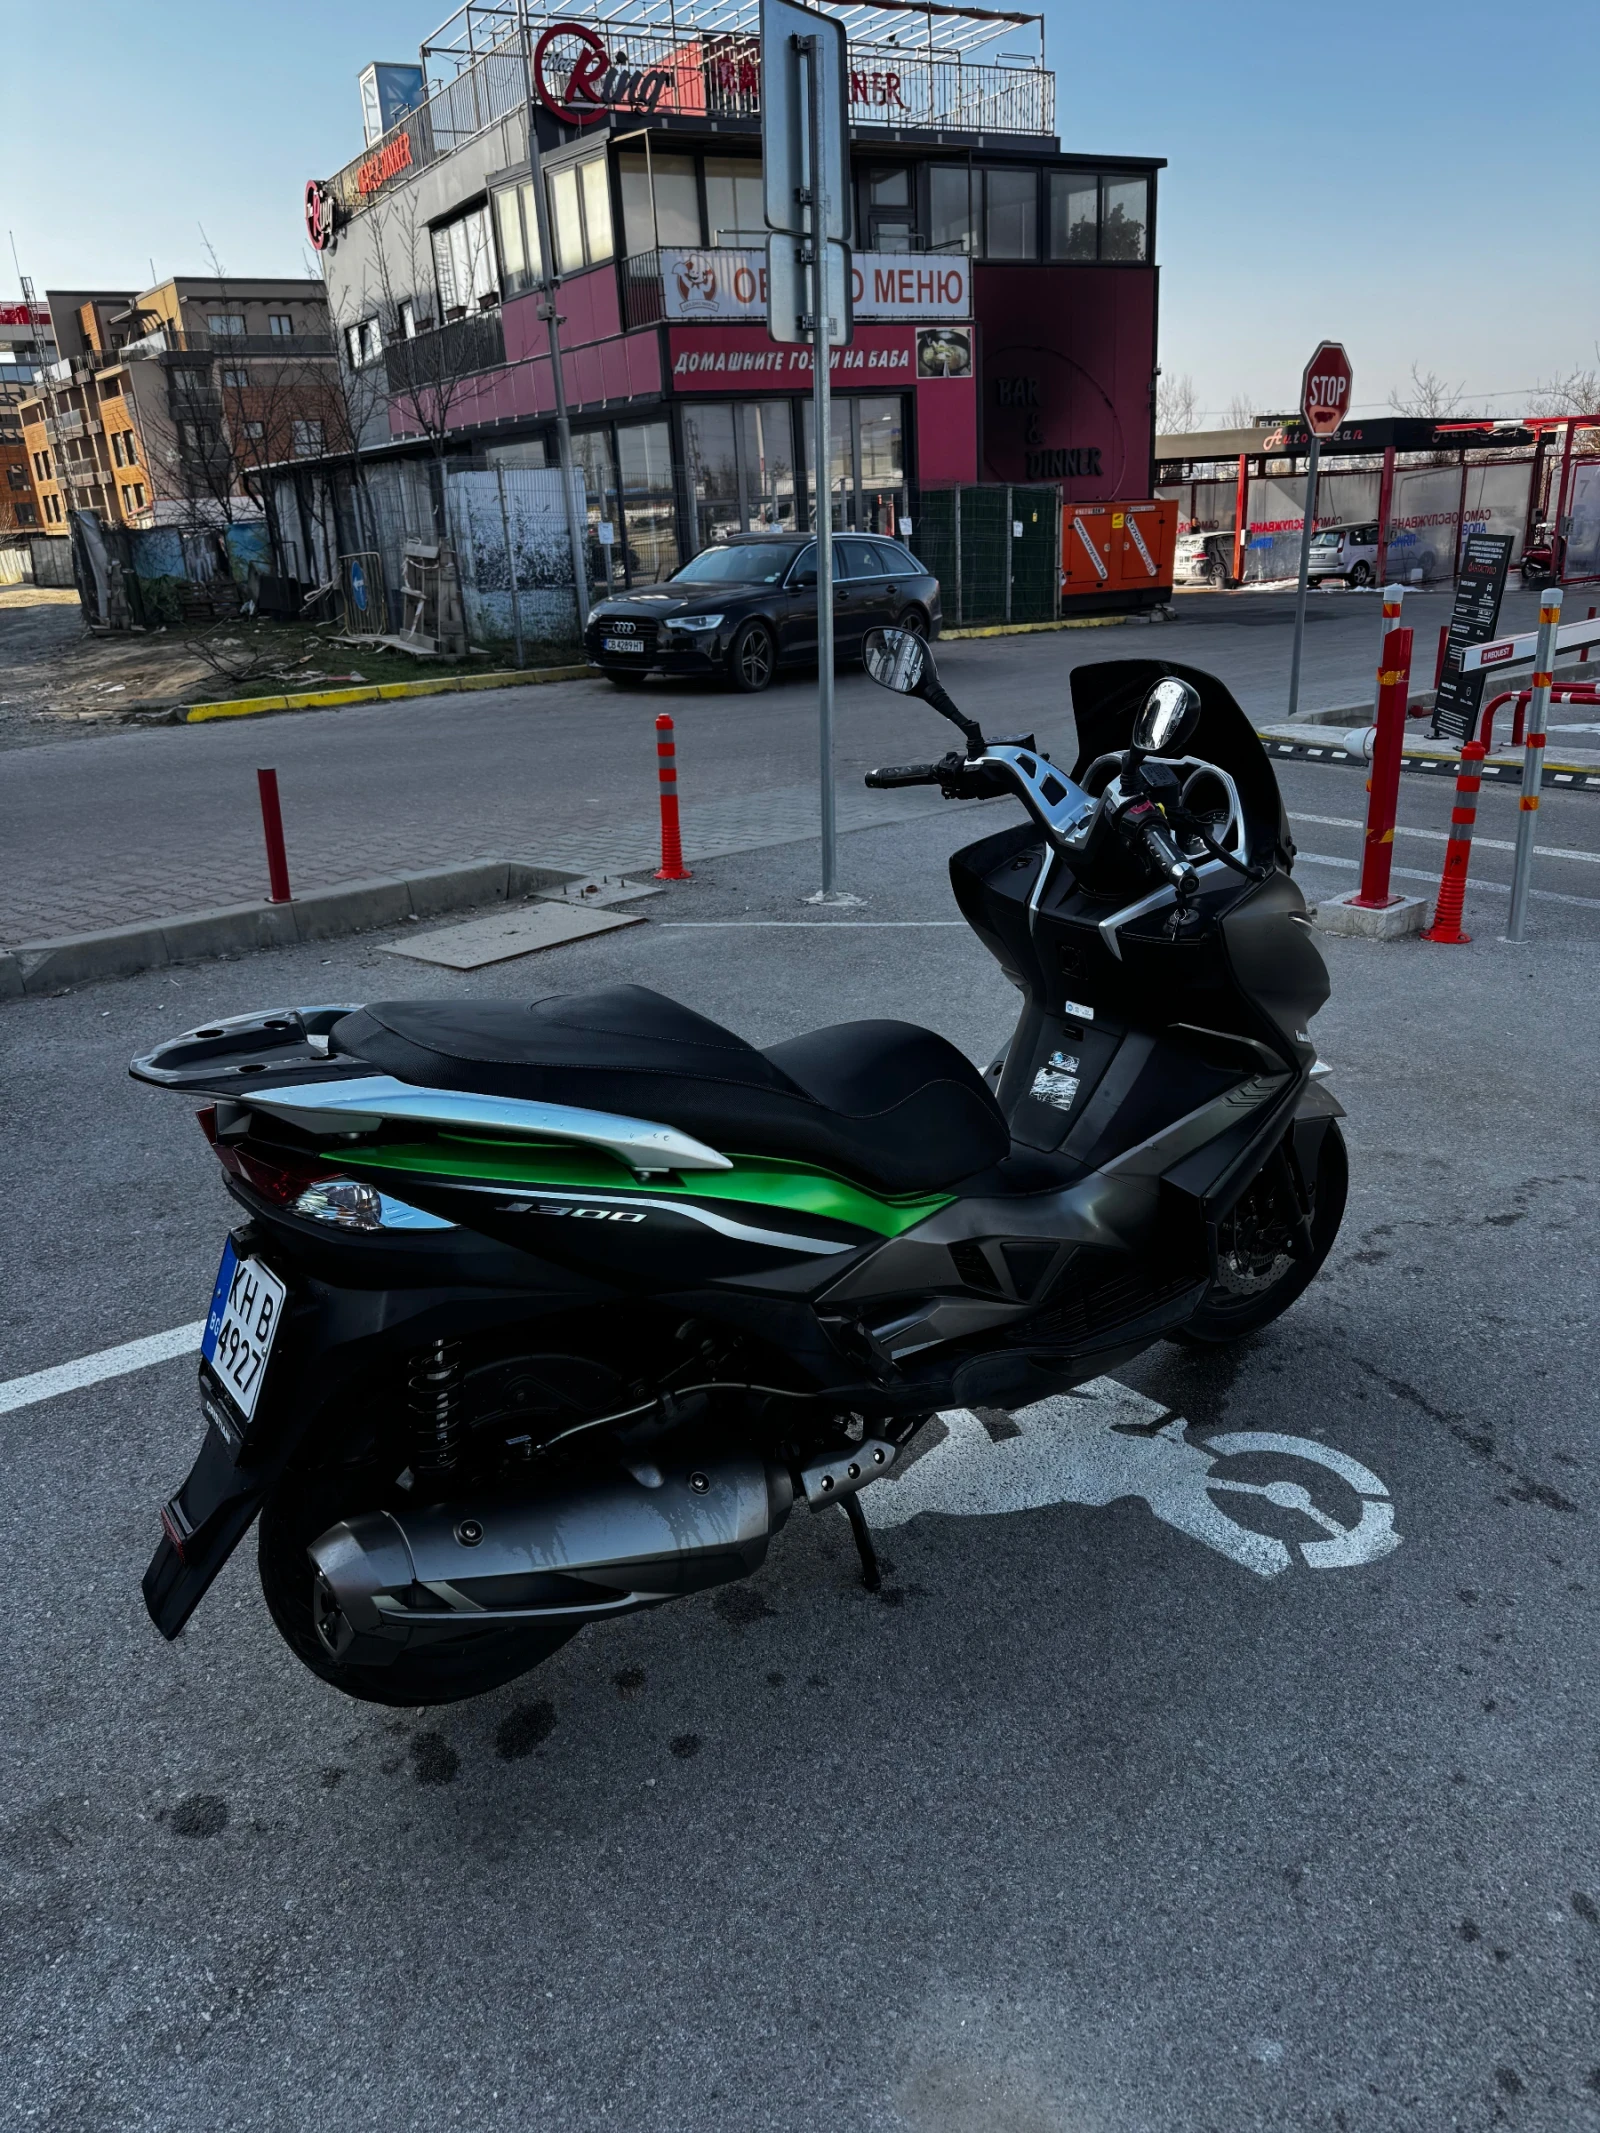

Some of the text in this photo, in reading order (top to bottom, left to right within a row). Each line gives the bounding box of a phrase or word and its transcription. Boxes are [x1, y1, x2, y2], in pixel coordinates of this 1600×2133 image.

[563, 44, 668, 117] Ring
[849, 69, 909, 111] NER
[874, 269, 963, 304] МЕНЮ
[674, 351, 785, 374] ДОМАШНИТЕ
[843, 350, 864, 369] НА
[868, 349, 909, 368] БАБА
[997, 376, 1040, 407] BAR
[1309, 376, 1347, 406] STOP
[1263, 428, 1308, 451] Auto
[1026, 447, 1104, 480] DINNER
[495, 1202, 648, 1223] J300
[228, 1262, 274, 1343] KH B
[209, 1310, 221, 1337] BG
[217, 1318, 262, 1394] 4927
